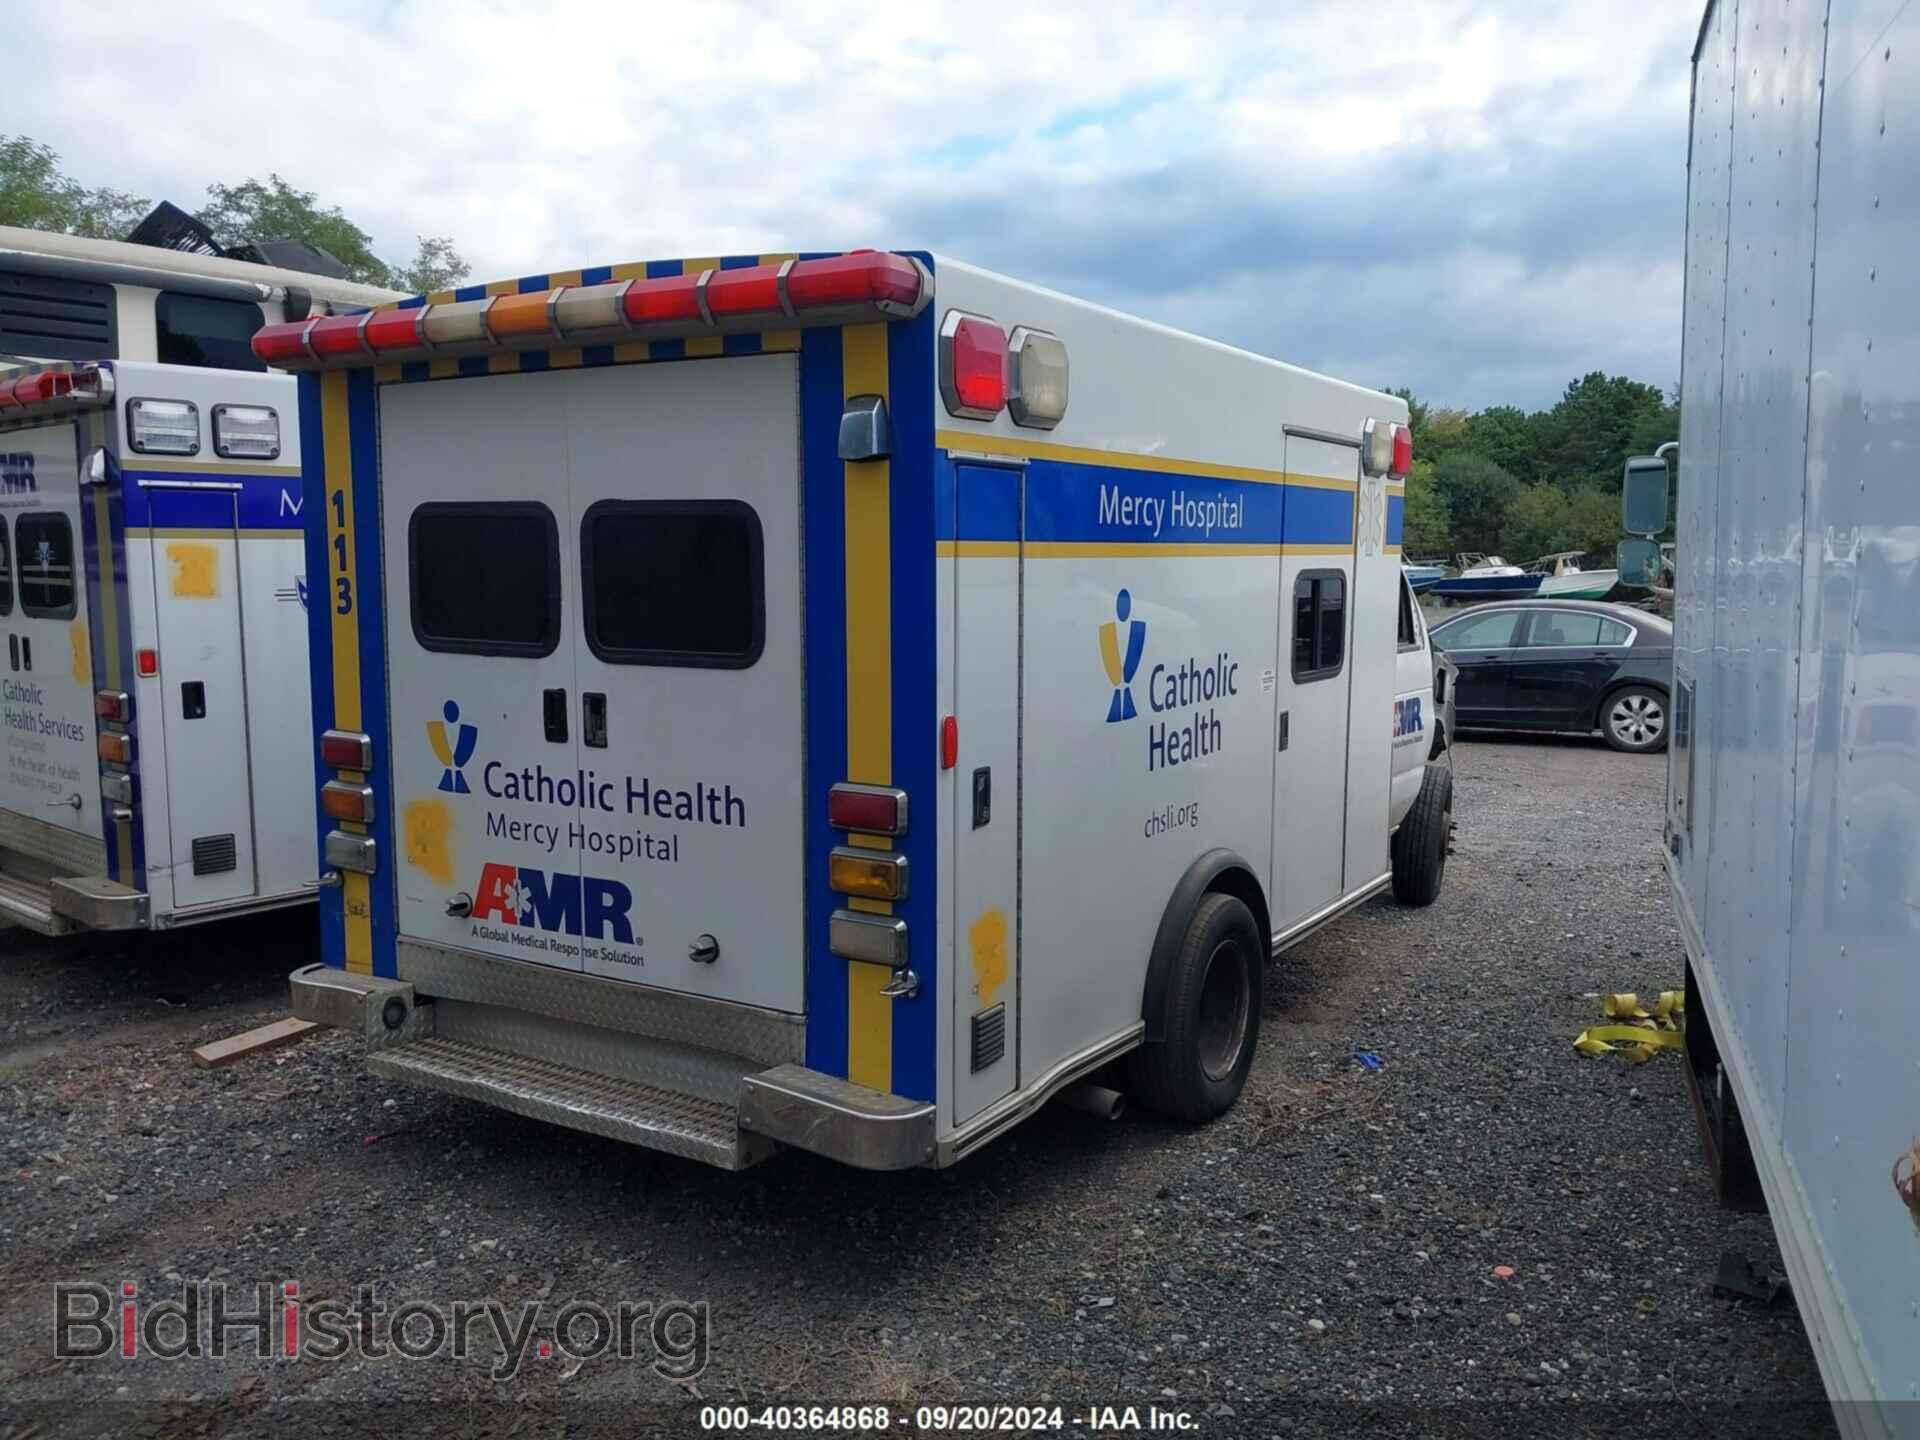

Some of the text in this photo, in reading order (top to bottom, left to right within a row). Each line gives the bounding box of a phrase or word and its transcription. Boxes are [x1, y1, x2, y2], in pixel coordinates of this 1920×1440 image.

[1099, 484, 1244, 538] Mercy Hospital
[331, 489, 353, 616] 113
[3, 679, 43, 706] Catholic
[1149, 652, 1239, 713] Catholic
[5, 706, 84, 742] Health Services
[1149, 709, 1222, 772] Health
[484, 761, 746, 827] Catholic Health
[1144, 801, 1199, 838] chsli.org
[486, 812, 679, 863] Mercy Hospital
[472, 925, 645, 967] A Global Medical Response Solution
